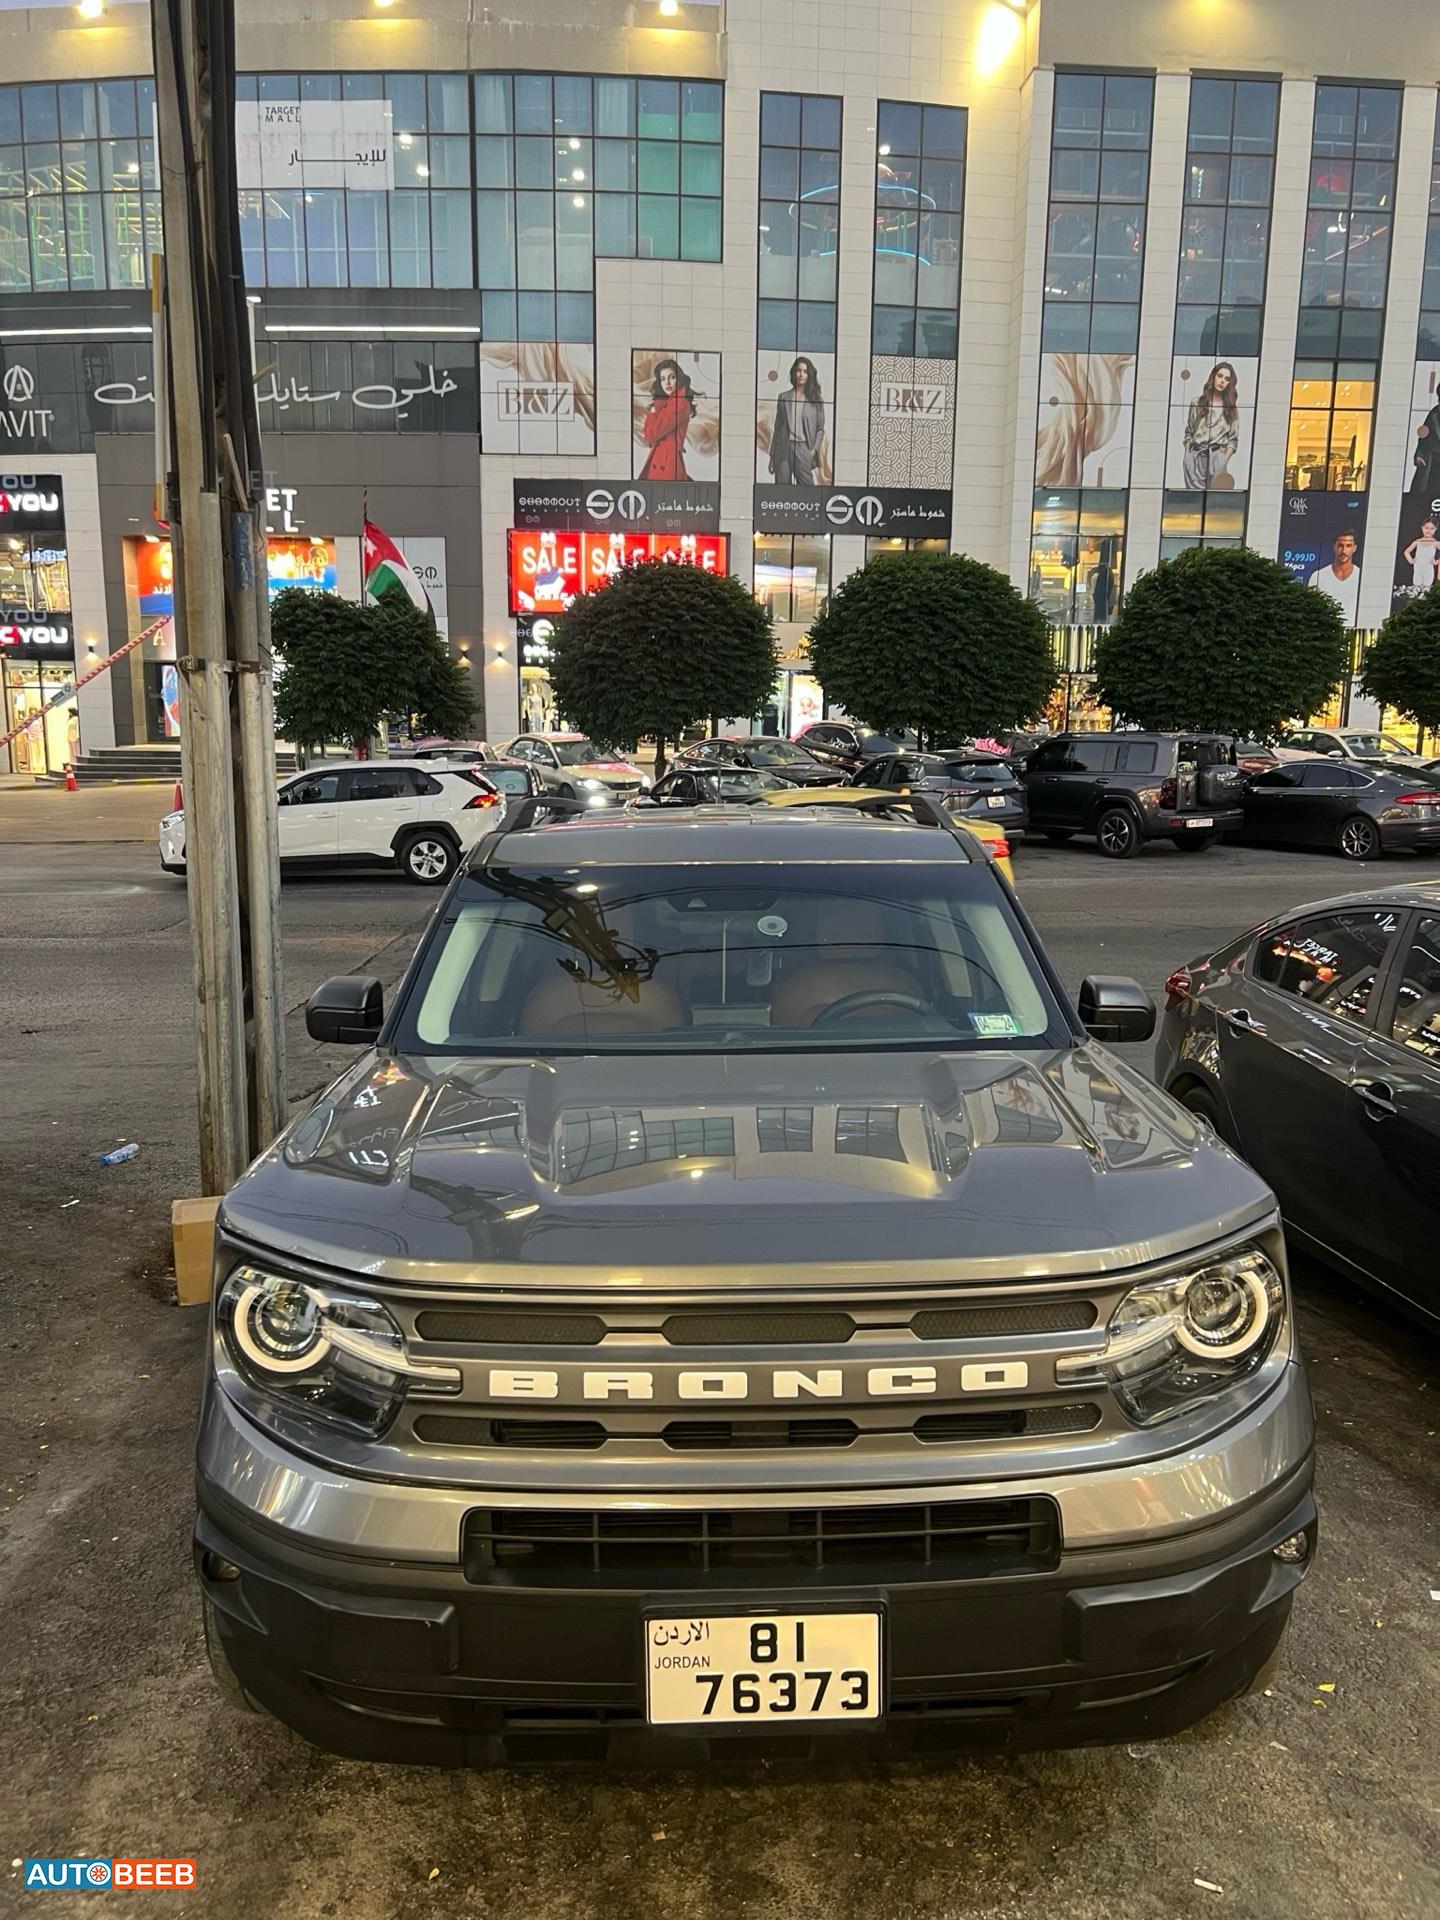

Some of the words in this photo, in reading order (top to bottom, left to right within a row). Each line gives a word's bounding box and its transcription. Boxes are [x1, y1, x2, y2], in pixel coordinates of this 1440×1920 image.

[265, 107, 300, 115] TARGET
[265, 115, 300, 123] MALL
[504, 386, 570, 415] B&Z
[521, 546, 577, 574] SALE
[489, 1361, 1028, 1399] BRONCO
[750, 1622, 805, 1663] 81
[654, 1655, 711, 1669] JORDAN
[695, 1670, 869, 1715] 76373
